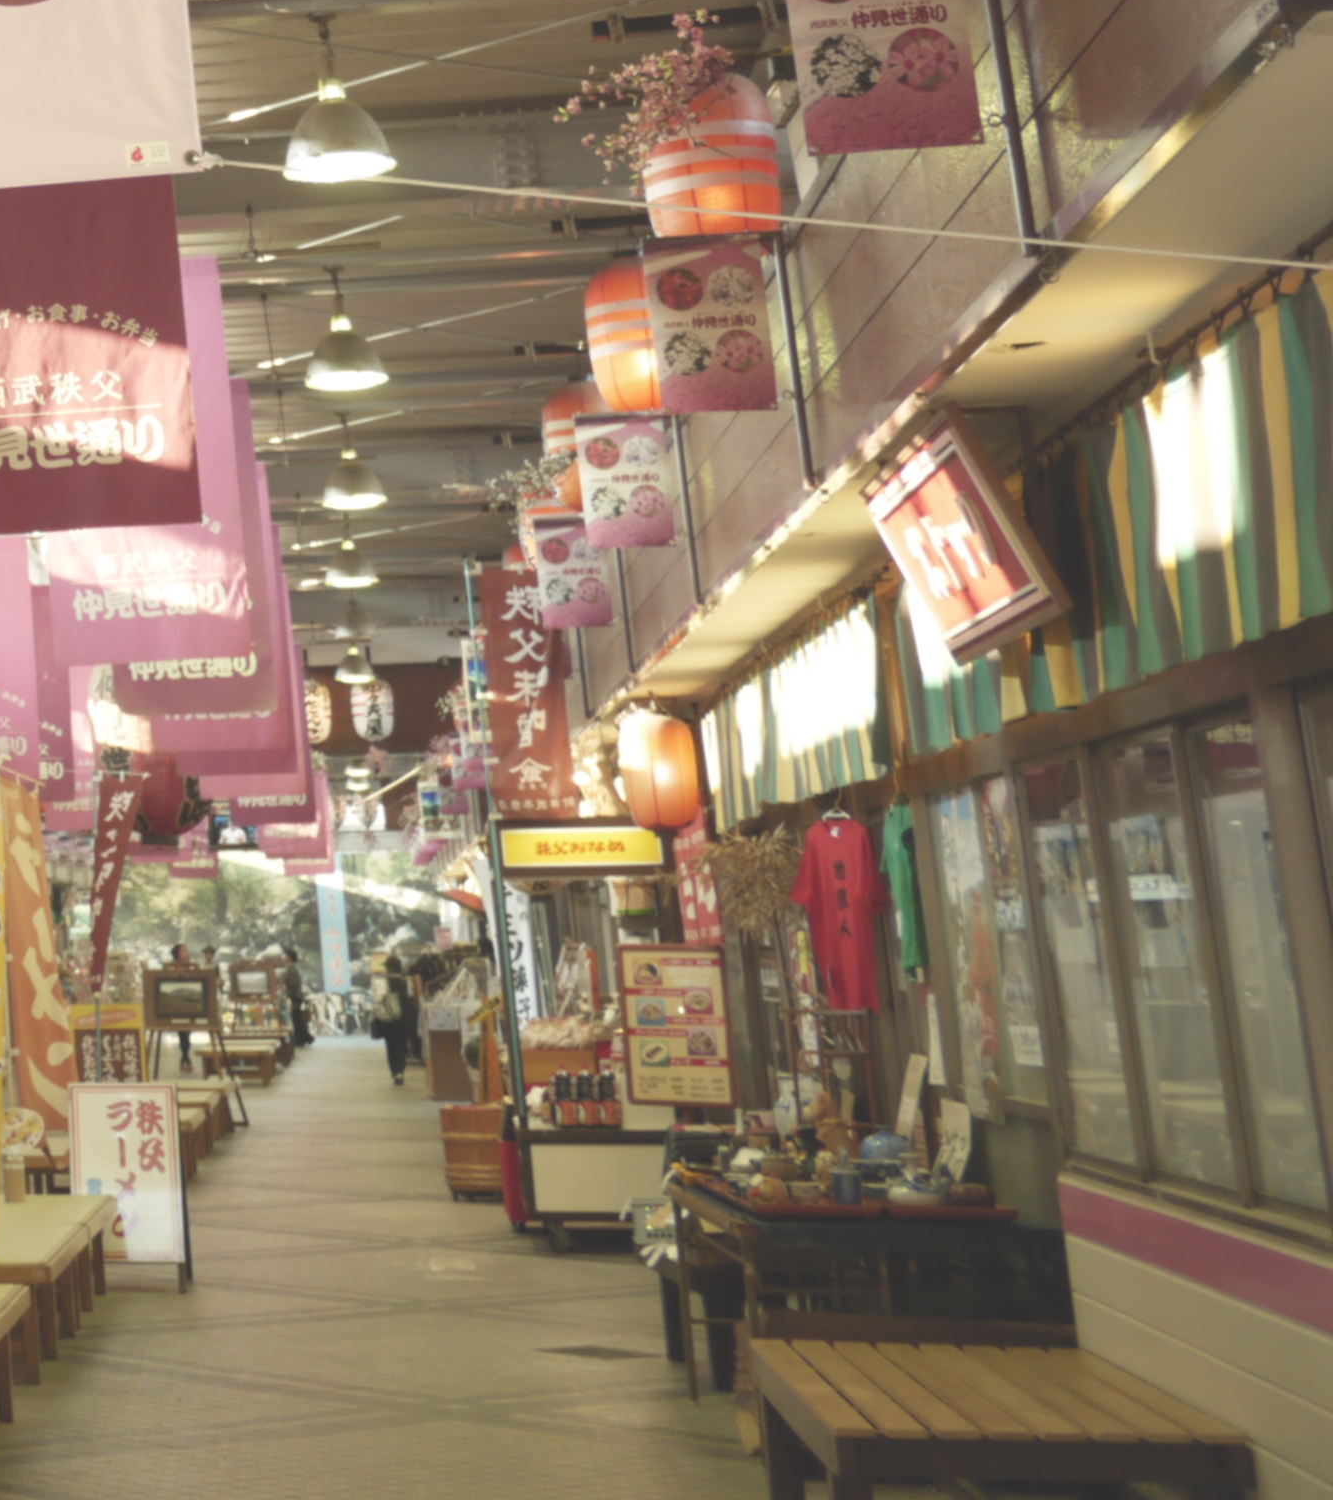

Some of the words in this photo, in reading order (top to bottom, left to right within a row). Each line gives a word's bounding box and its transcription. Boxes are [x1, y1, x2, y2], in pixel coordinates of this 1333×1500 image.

[851, 4, 949, 29] 仲見世通り
[72, 581, 227, 622] 仲見世通り
[128, 650, 258, 682] 仲見世通り
[135, 1099, 166, 1174] 秩父
